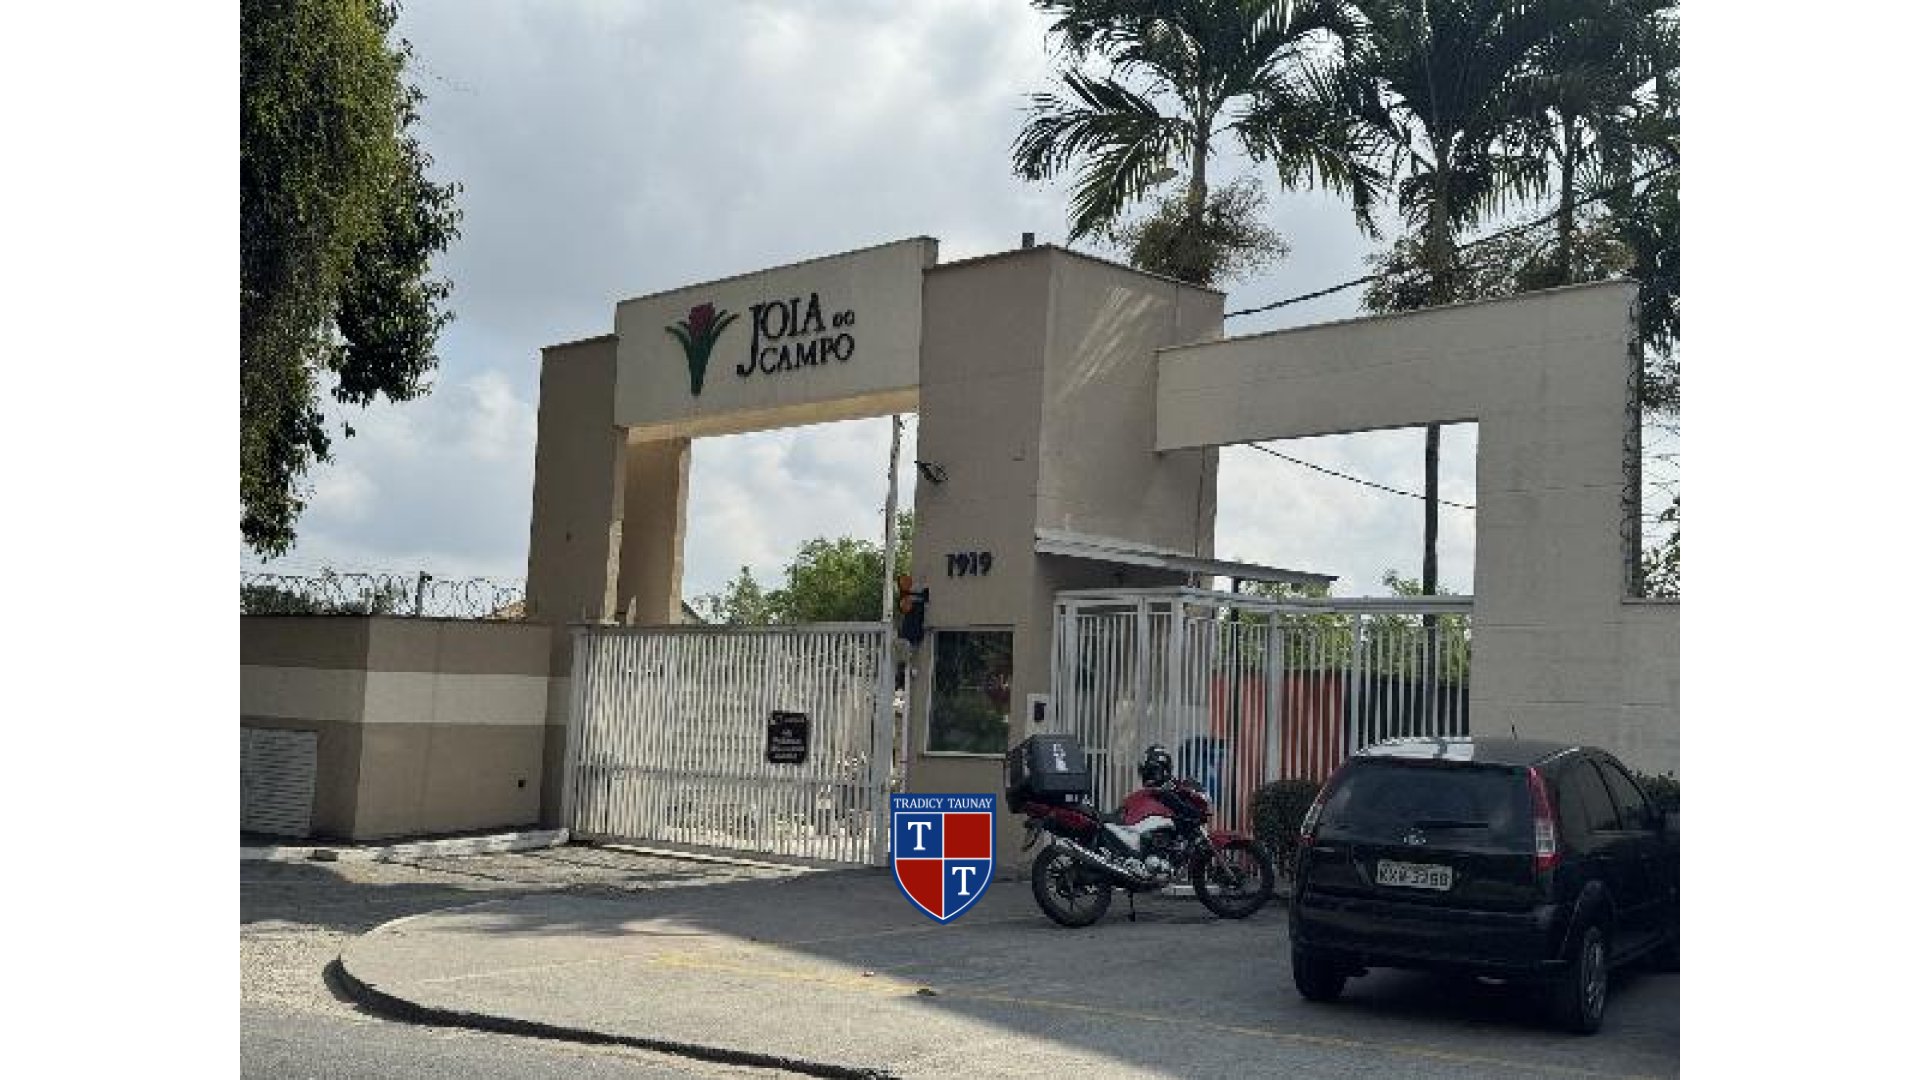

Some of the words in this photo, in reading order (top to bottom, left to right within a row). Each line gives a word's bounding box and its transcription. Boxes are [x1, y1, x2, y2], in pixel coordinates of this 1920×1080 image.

[737, 293, 826, 377] JOIA
[760, 333, 855, 375] CAMPO
[945, 551, 992, 578] 1919
